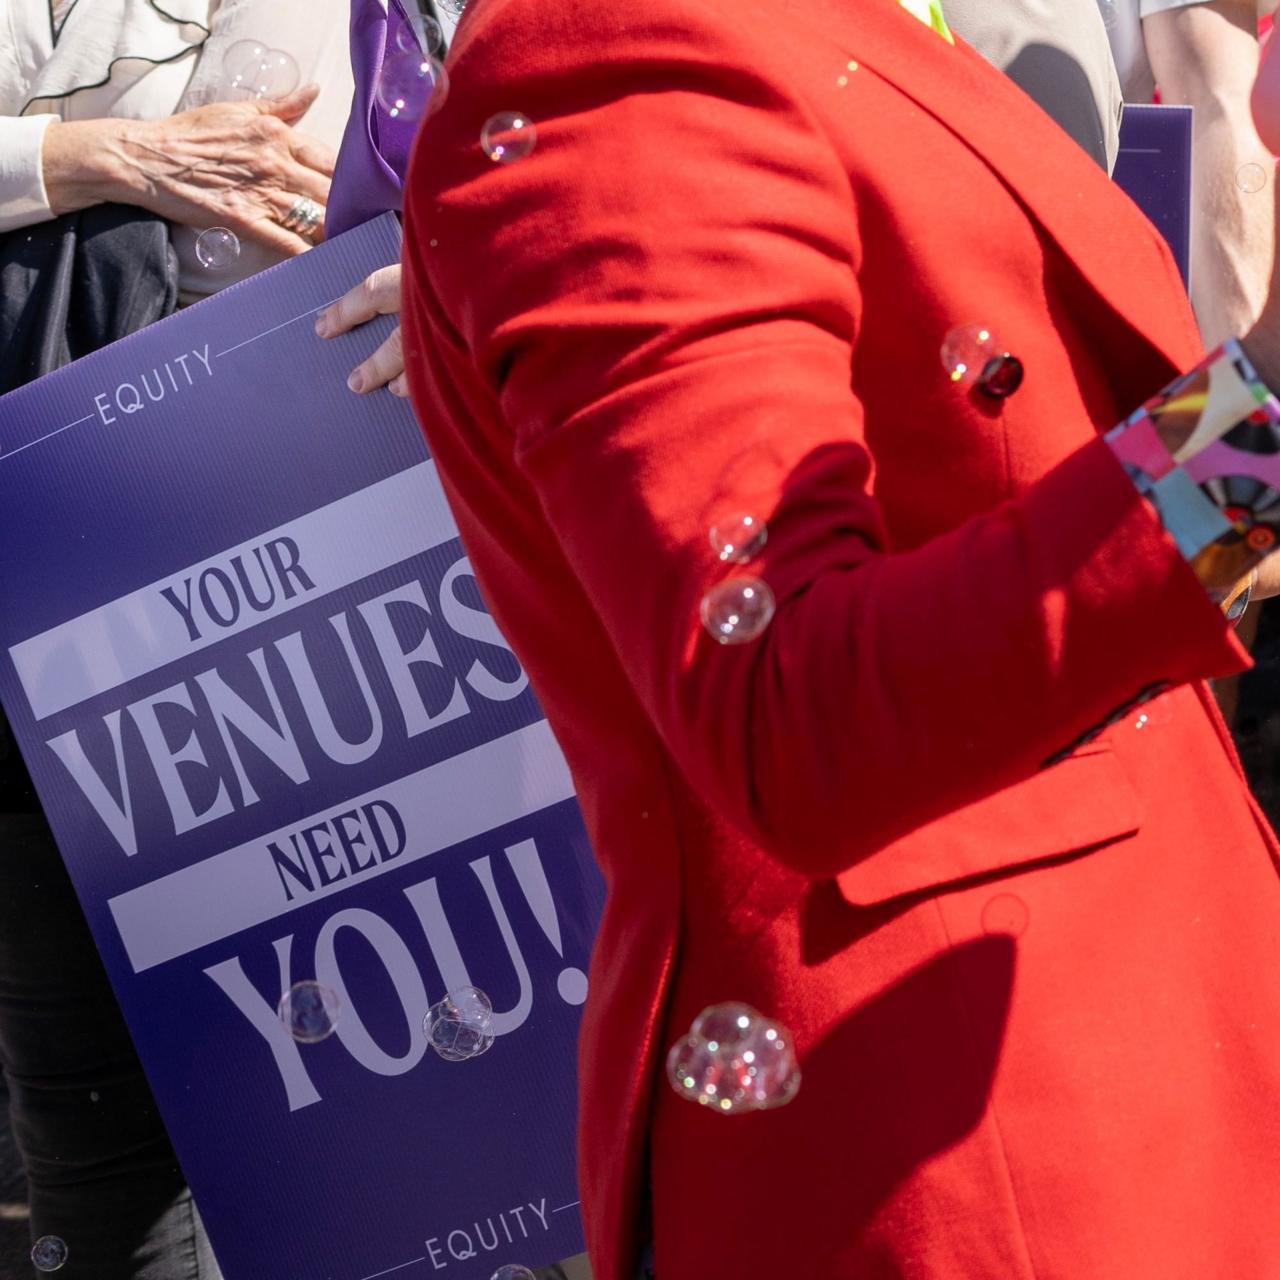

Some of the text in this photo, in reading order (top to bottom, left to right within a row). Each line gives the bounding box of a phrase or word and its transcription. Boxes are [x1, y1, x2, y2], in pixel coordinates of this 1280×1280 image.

[94, 344, 213, 425] EQUITY
[160, 536, 317, 641] YOUR
[45, 555, 530, 857] VENUES
[266, 798, 407, 902] NEED
[202, 837, 589, 1113] YOU!
[424, 1198, 549, 1270] EQUITY
